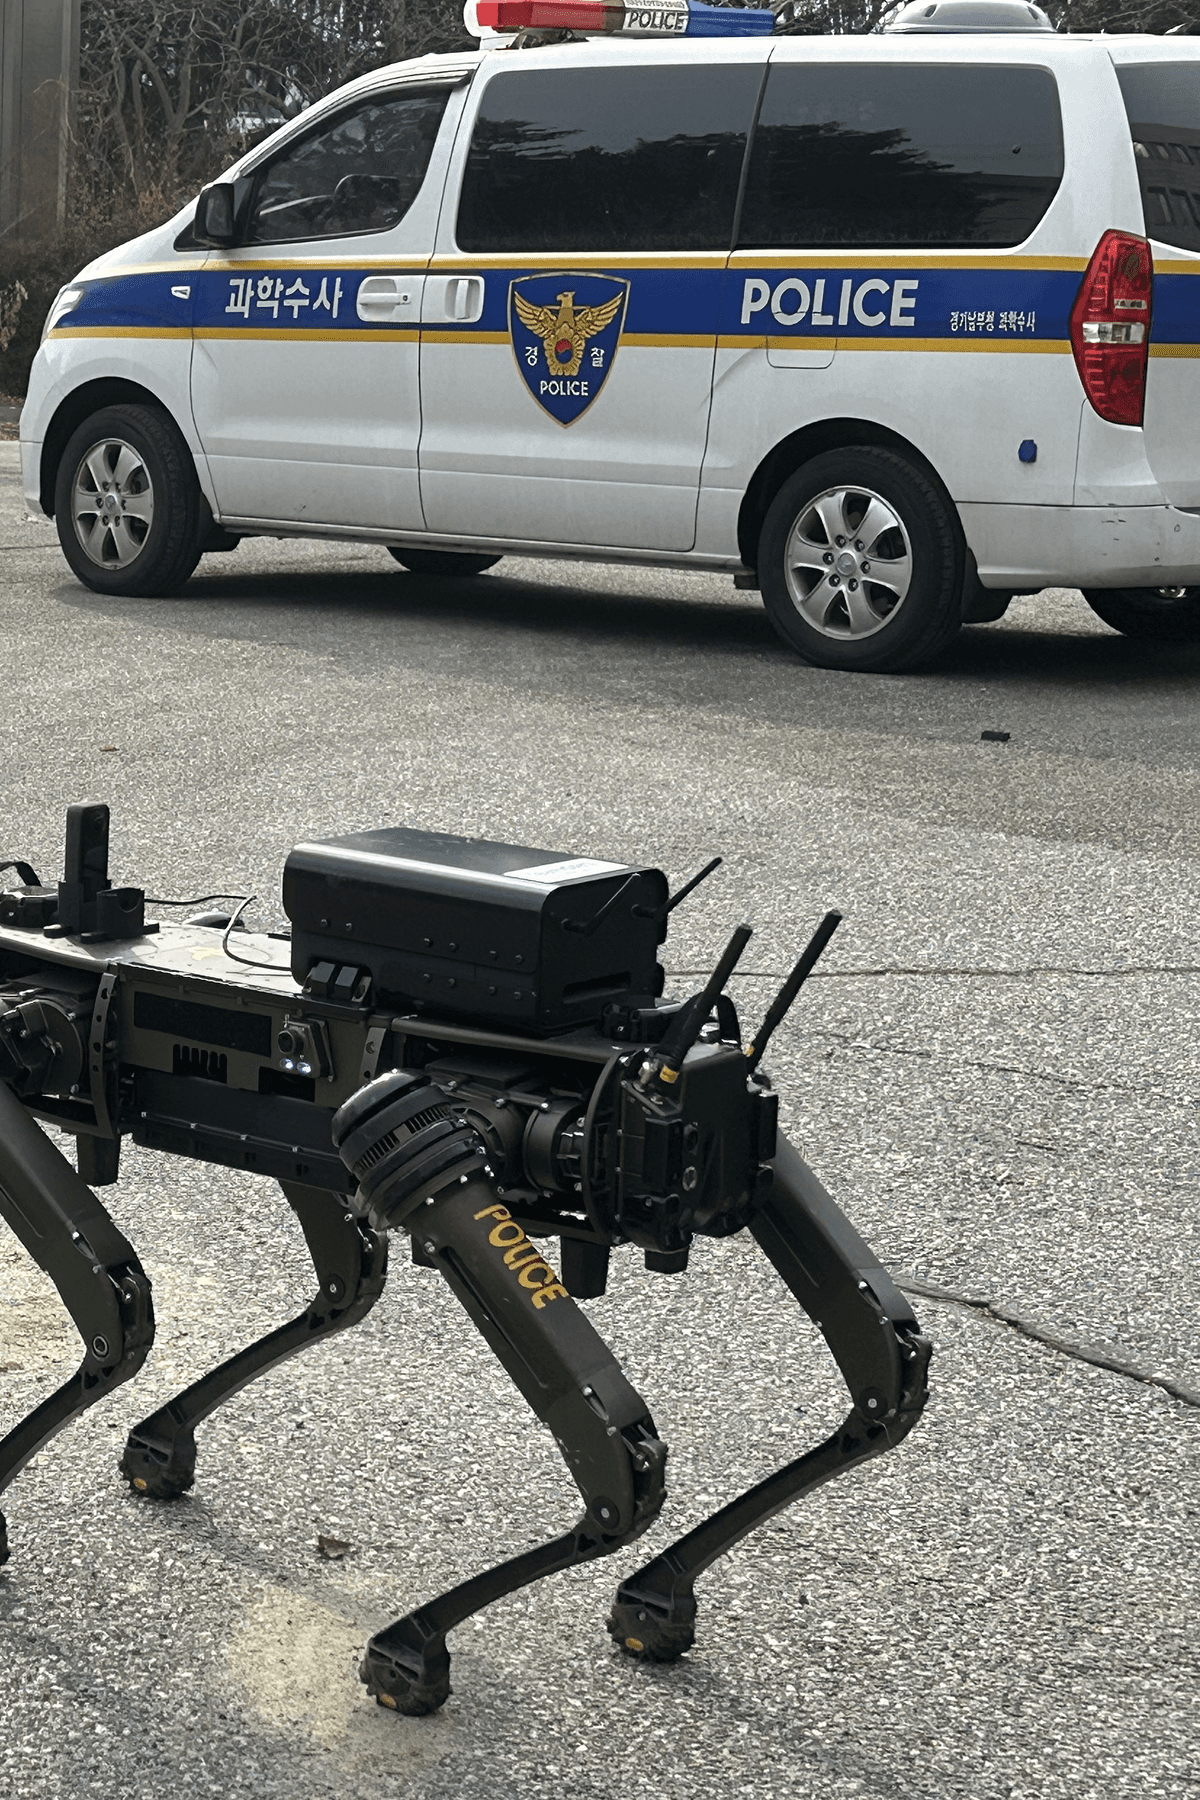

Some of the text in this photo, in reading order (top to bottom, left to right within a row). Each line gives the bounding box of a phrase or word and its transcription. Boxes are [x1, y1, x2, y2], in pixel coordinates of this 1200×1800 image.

[628, 11, 685, 30] POLICE
[225, 276, 343, 319] 과학수사
[740, 278, 919, 327] POLICE
[540, 380, 589, 396] POLICE
[473, 1204, 570, 1310] POLICE
